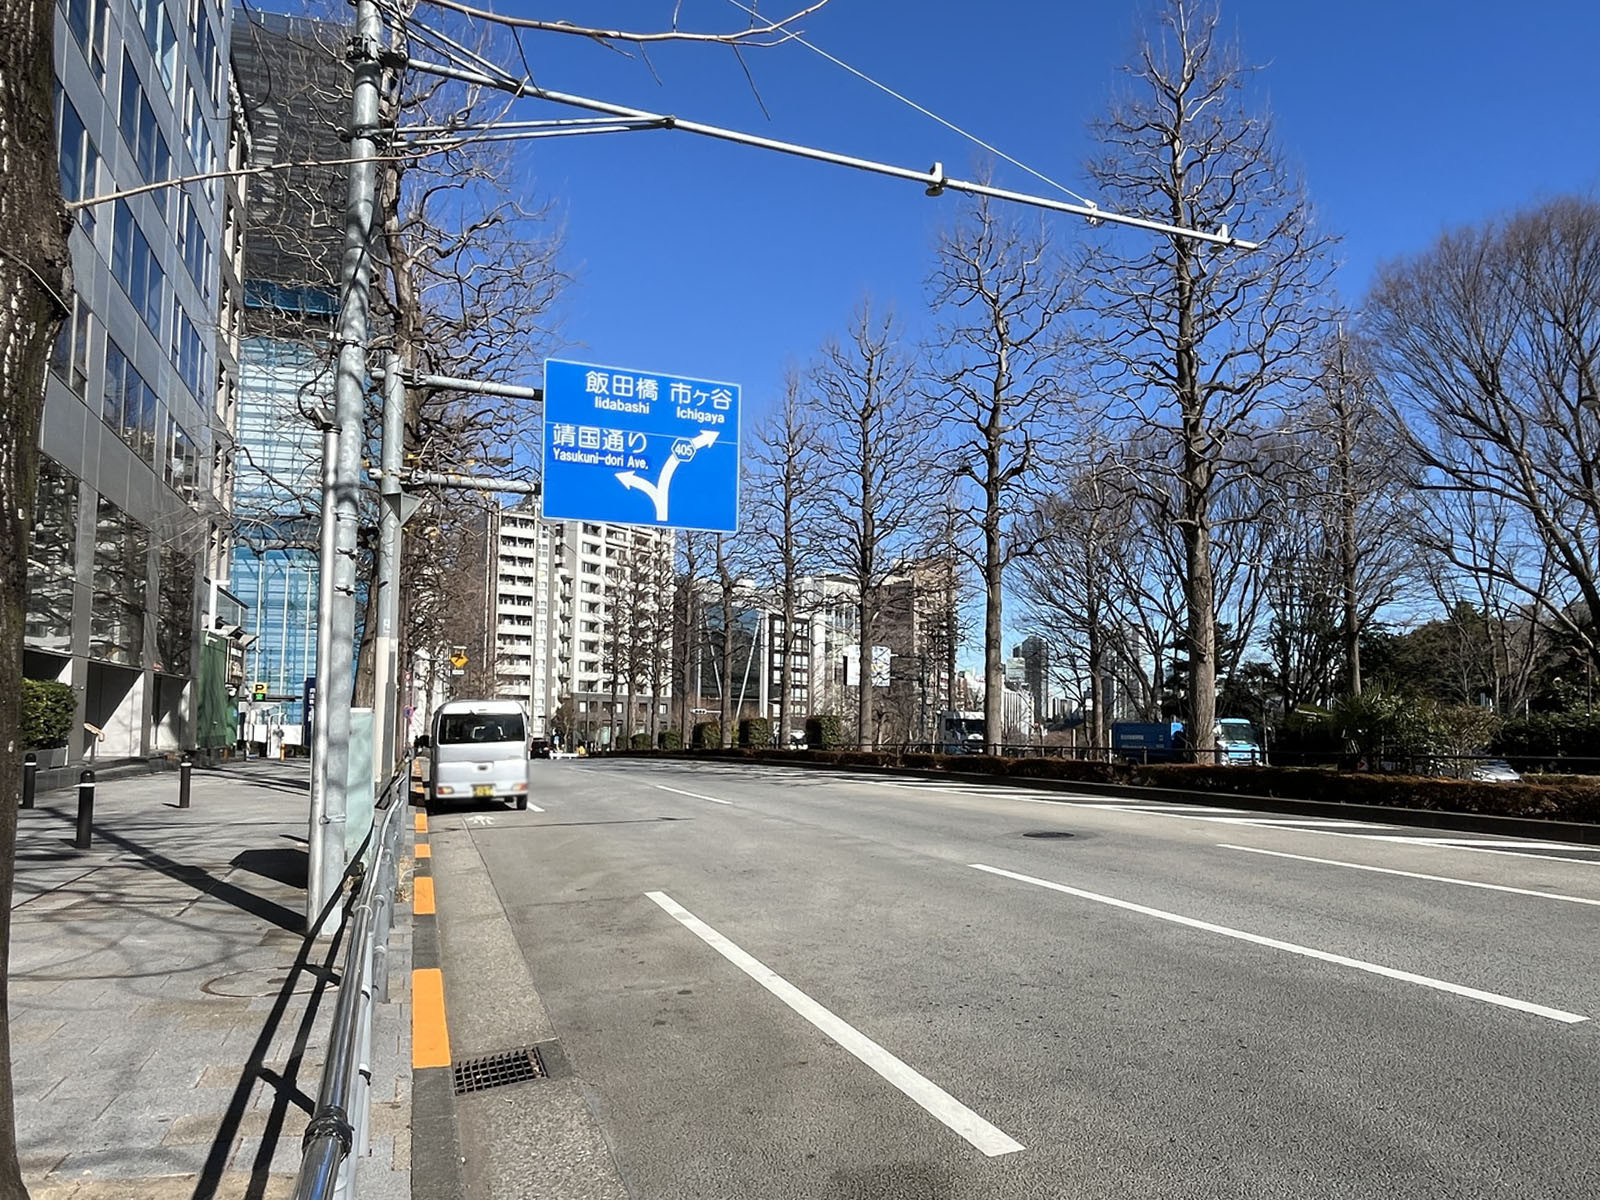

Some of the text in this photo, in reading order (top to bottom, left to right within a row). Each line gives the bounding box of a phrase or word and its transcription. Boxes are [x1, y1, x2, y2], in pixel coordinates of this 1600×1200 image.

[585, 370, 659, 402] 飯田橋
[594, 397, 650, 414] Iidabashi
[676, 406, 725, 424] Ichigaya
[552, 424, 648, 453] 靖国通り
[553, 448, 649, 470] Yasukuni-dori Ave.
[674, 444, 693, 457] 405
[255, 684, 264, 692] P
